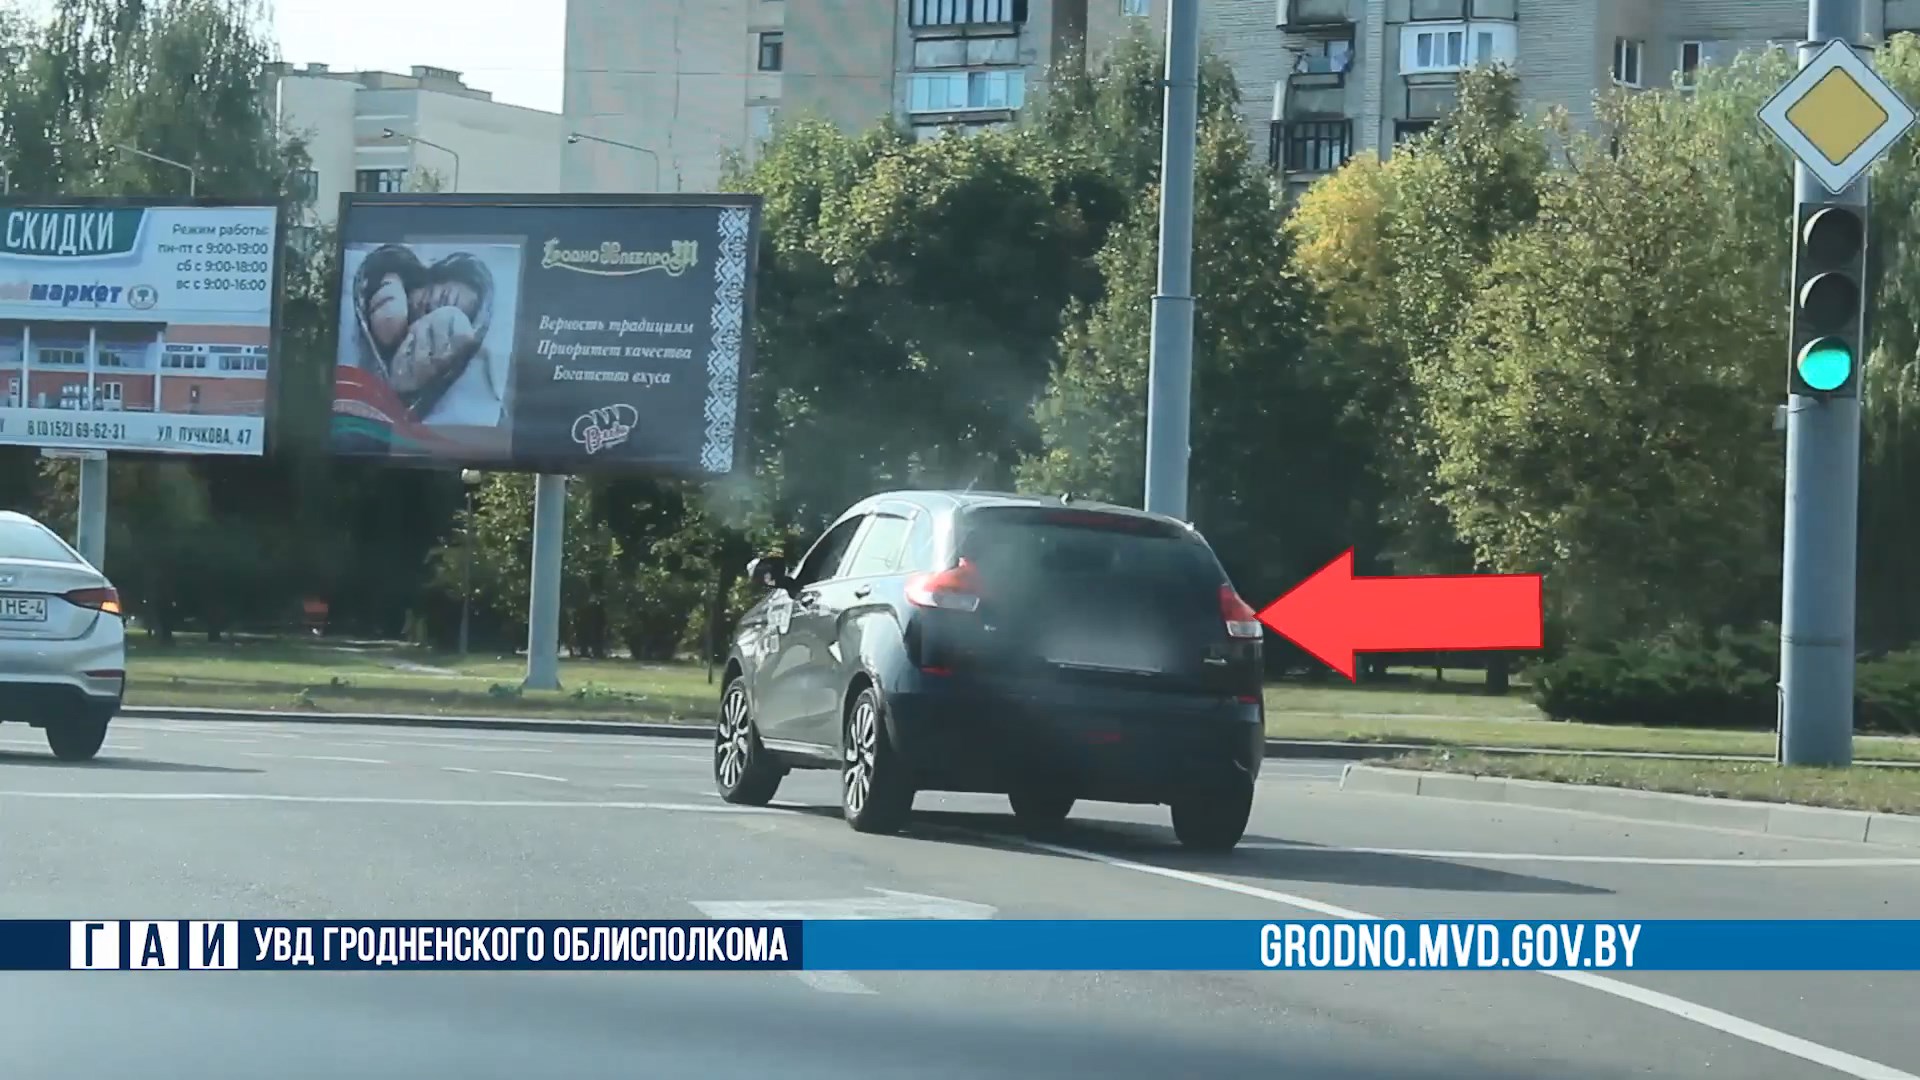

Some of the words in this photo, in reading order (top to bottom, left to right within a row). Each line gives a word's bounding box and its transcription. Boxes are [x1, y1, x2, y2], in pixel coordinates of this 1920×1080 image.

[6, 211, 115, 255] СКИДКИ
[173, 223, 217, 234] Режим
[158, 243, 193, 253] пн-пт
[206, 242, 269, 255] 9:00-19:00
[177, 259, 192, 272] сб
[205, 260, 268, 273] 9:00-18:00
[203, 278, 267, 291] 9:00-16:00
[539, 315, 604, 335] Верность
[609, 319, 694, 337] традициям
[537, 340, 621, 360] Приоритет
[624, 346, 693, 359] качества
[553, 365, 629, 383] Богатство
[632, 371, 671, 388] вкуса
[76, 422, 126, 440] 69-62-31
[237, 429, 252, 444] 47
